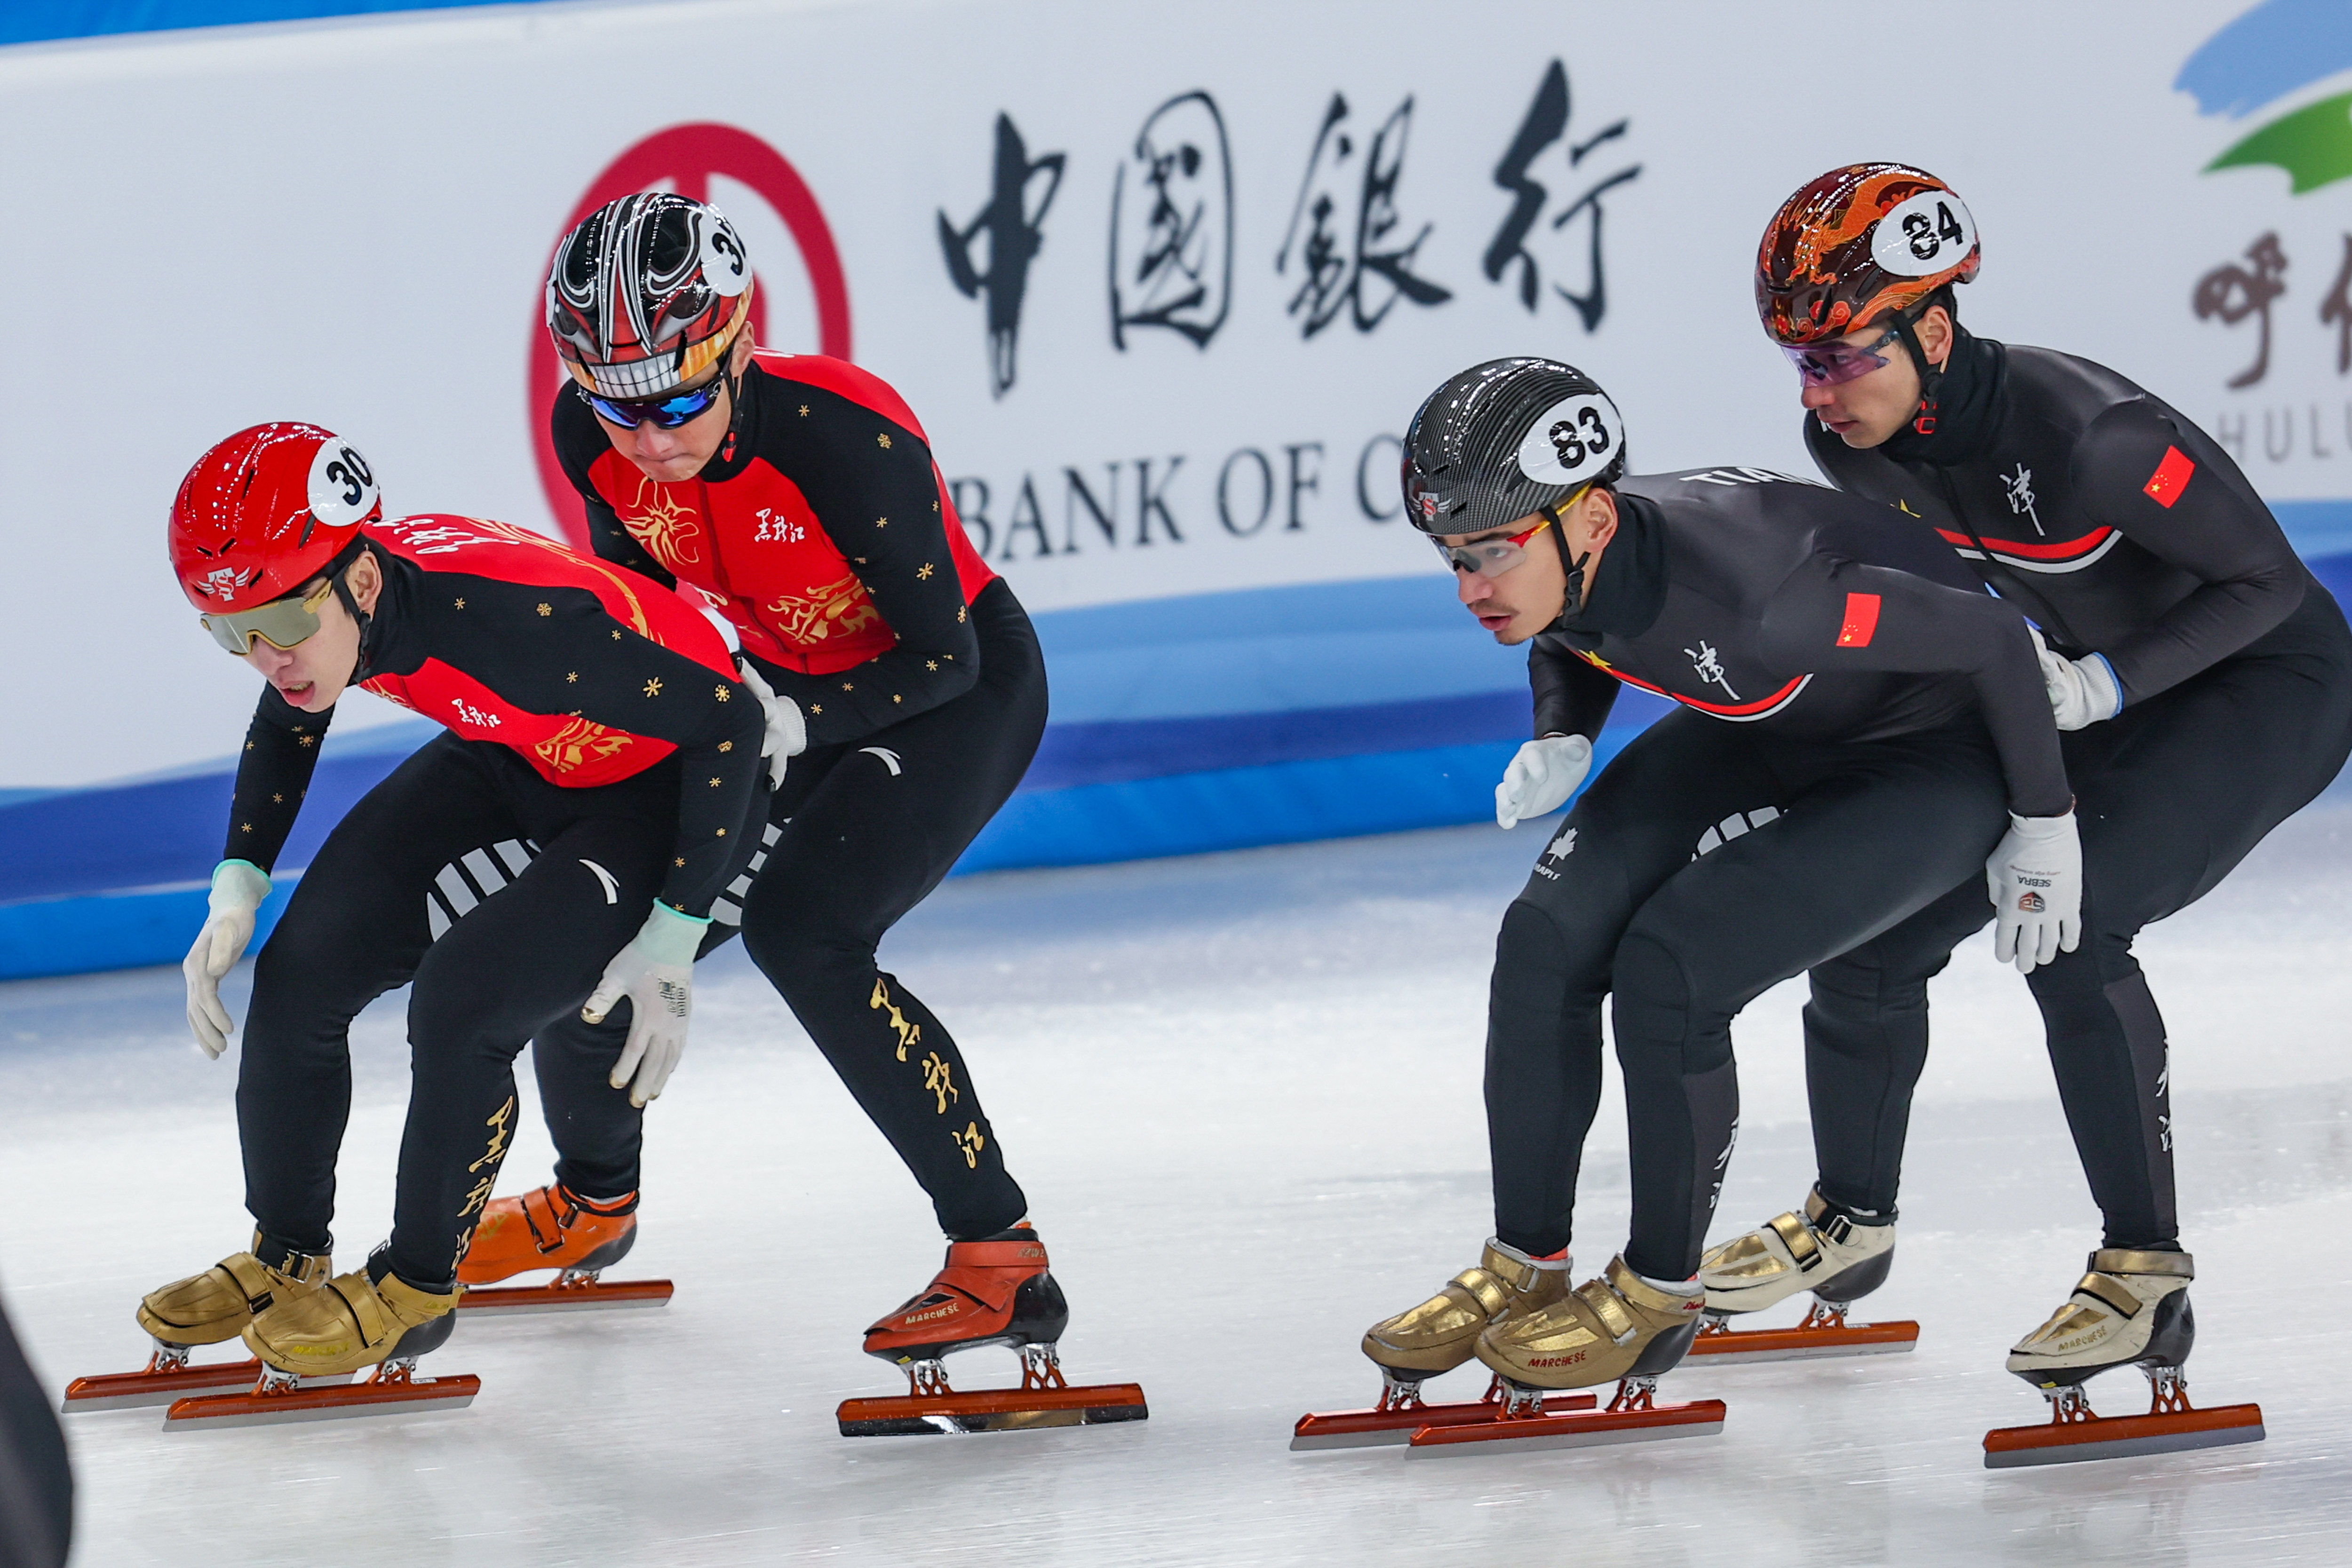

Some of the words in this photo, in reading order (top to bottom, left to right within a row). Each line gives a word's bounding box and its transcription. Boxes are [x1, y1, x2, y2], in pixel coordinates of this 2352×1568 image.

[938, 54, 1645, 401] 中國銀行
[1902, 200, 1963, 260] 84
[1549, 406, 1609, 469] 83
[2216, 405, 2352, 465] HUL
[326, 446, 373, 506] 30
[949, 454, 1186, 563] BANK
[1217, 440, 1327, 539] OF
[2017, 875, 2051, 887] SEBRA
[905, 1302, 960, 1324] MARCHESE
[2058, 1325, 2107, 1352] MARCHESE
[1527, 1349, 1587, 1368] MARCHESE
